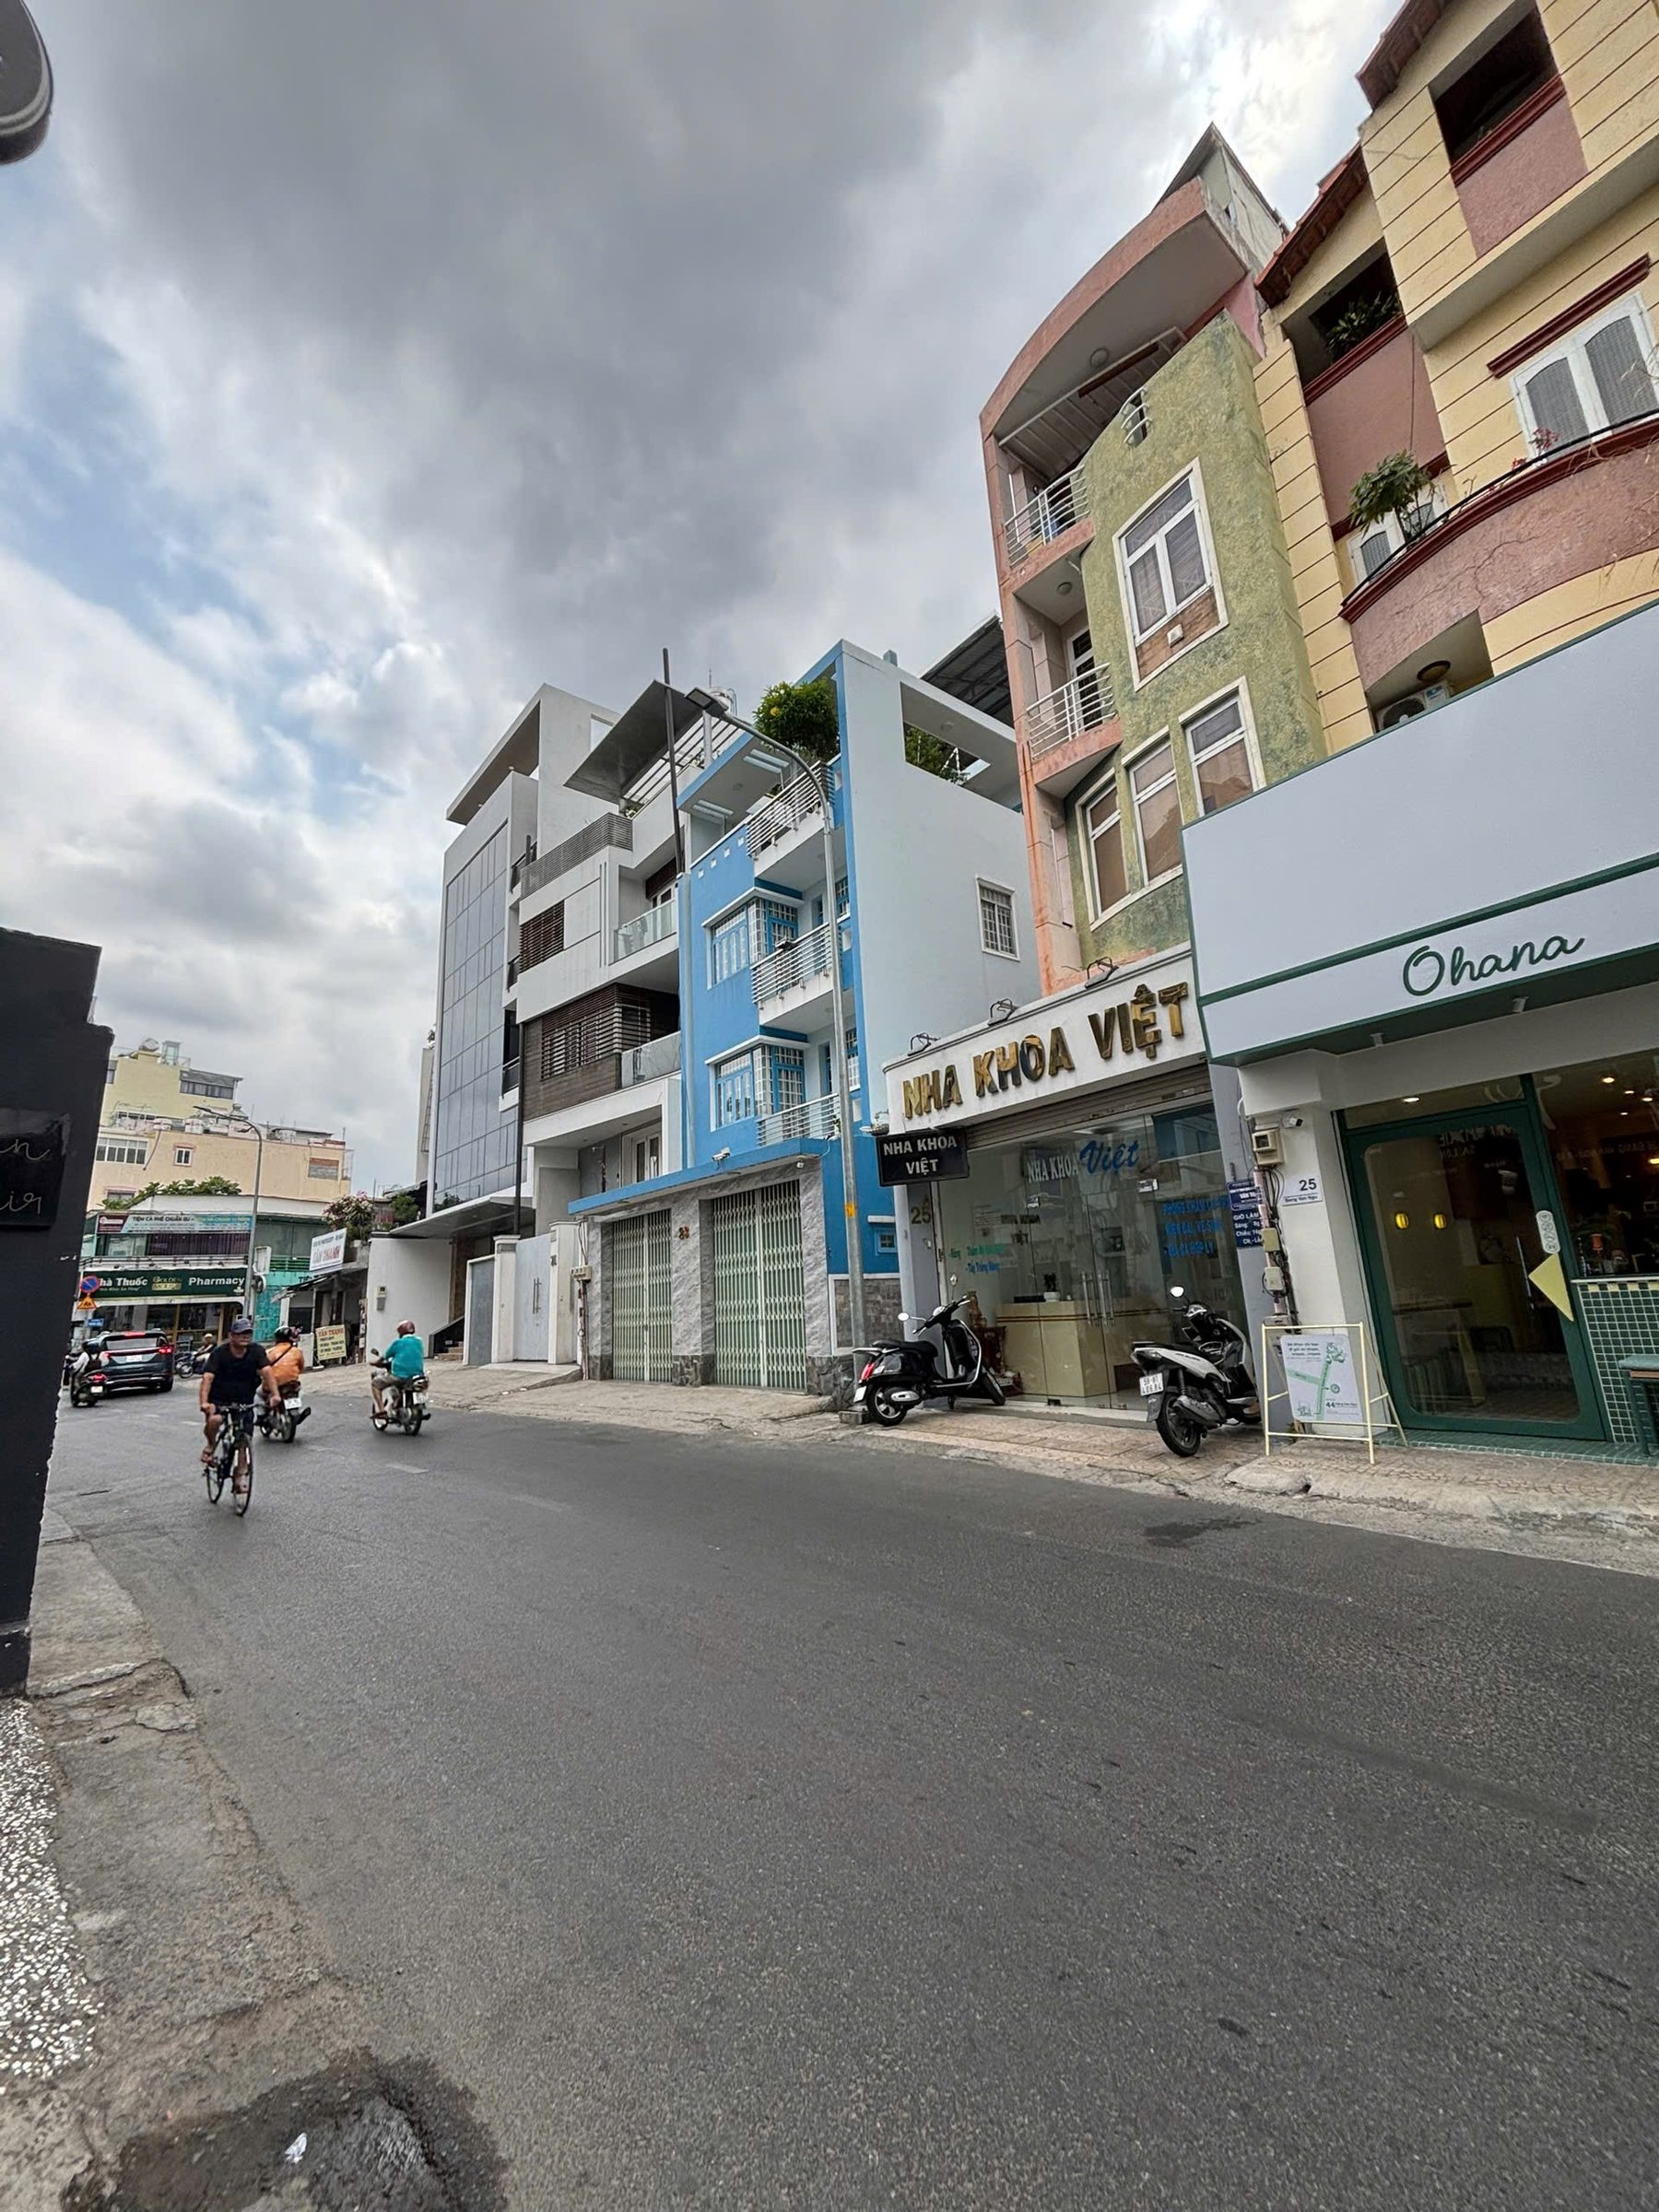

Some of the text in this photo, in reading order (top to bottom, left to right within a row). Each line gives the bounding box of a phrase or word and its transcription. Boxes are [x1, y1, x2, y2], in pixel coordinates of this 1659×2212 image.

[1403, 935, 1585, 996] Ohana
[902, 982, 1189, 1120] NHA KHOA VIỆT
[883, 1135, 958, 1155] NHA KHOA
[906, 1157, 938, 1175] VIỆT
[1027, 1140, 1139, 1182] NHA KHOA Việt
[1300, 1179, 1318, 1192] 25
[911, 1206, 931, 1225] 25
[99, 1276, 148, 1287] hà Thuốc
[188, 1276, 245, 1287] Pharmacy
